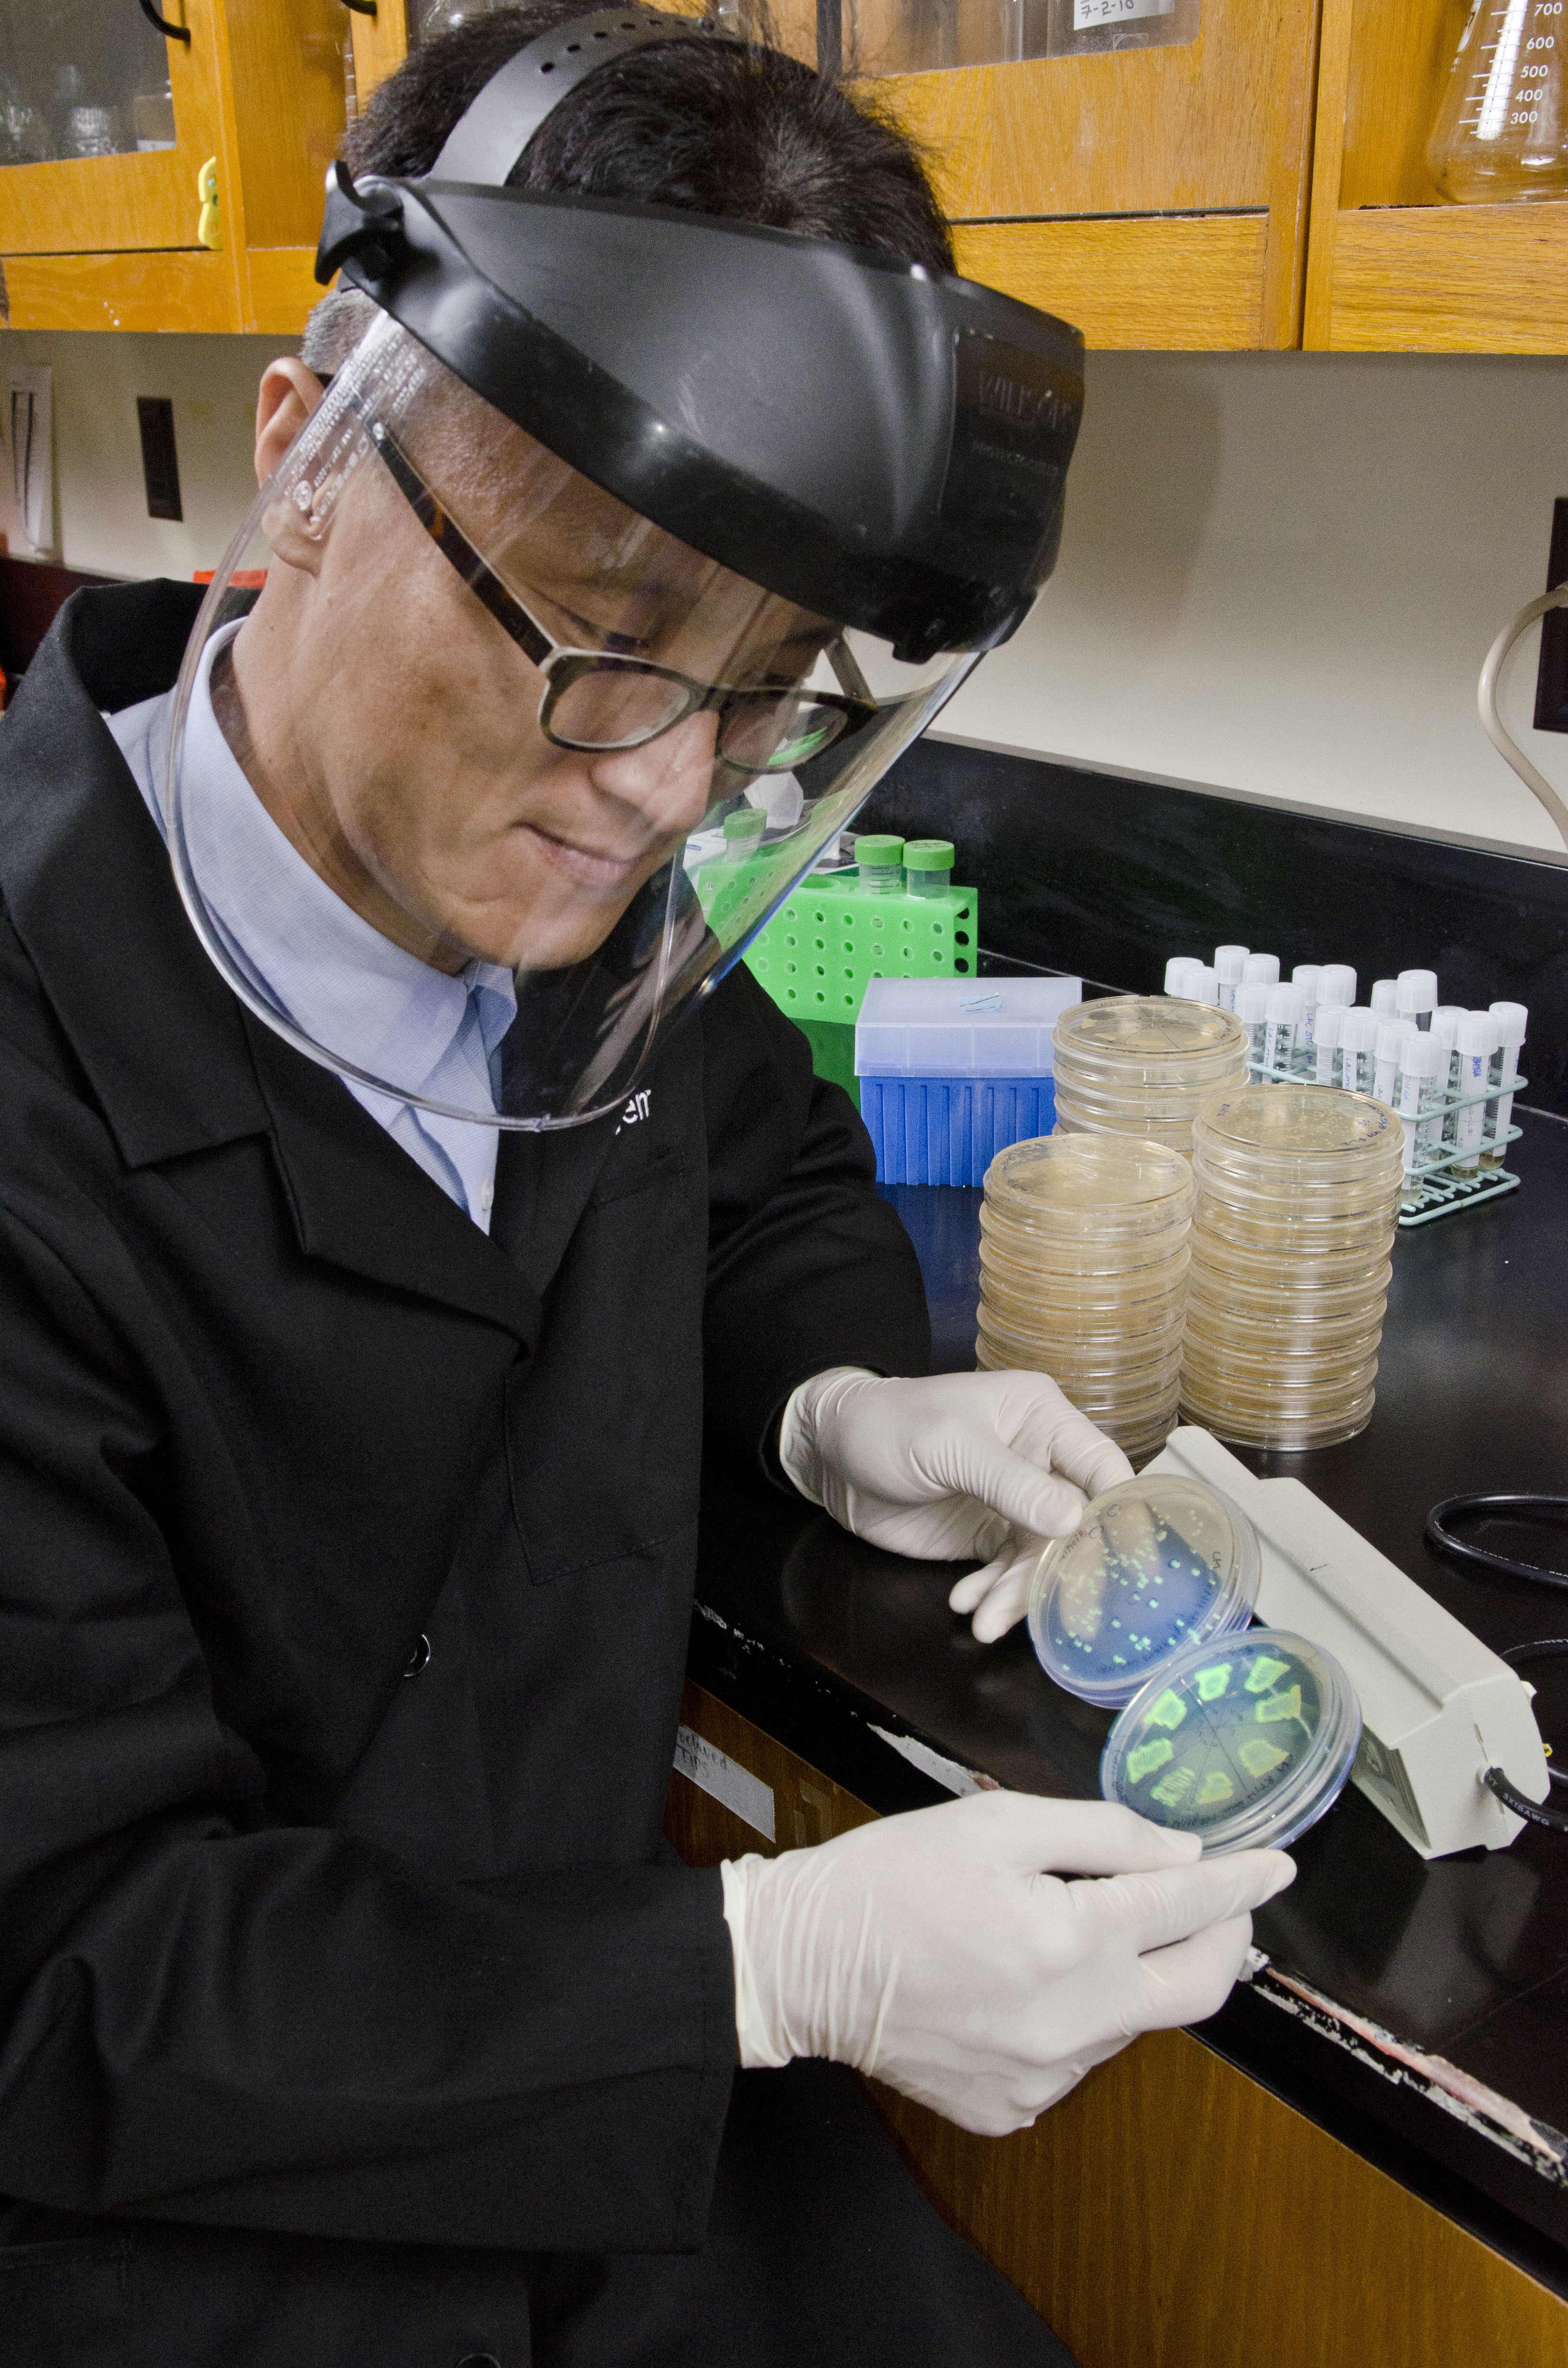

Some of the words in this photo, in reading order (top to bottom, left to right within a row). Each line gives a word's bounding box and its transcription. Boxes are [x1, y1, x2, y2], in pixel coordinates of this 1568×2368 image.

[1534, 2, 1563, 16] 700
[1526, 35, 1555, 50] 600
[1520, 64, 1549, 78] 500
[1515, 88, 1544, 102] 400
[1510, 111, 1538, 125] 300
